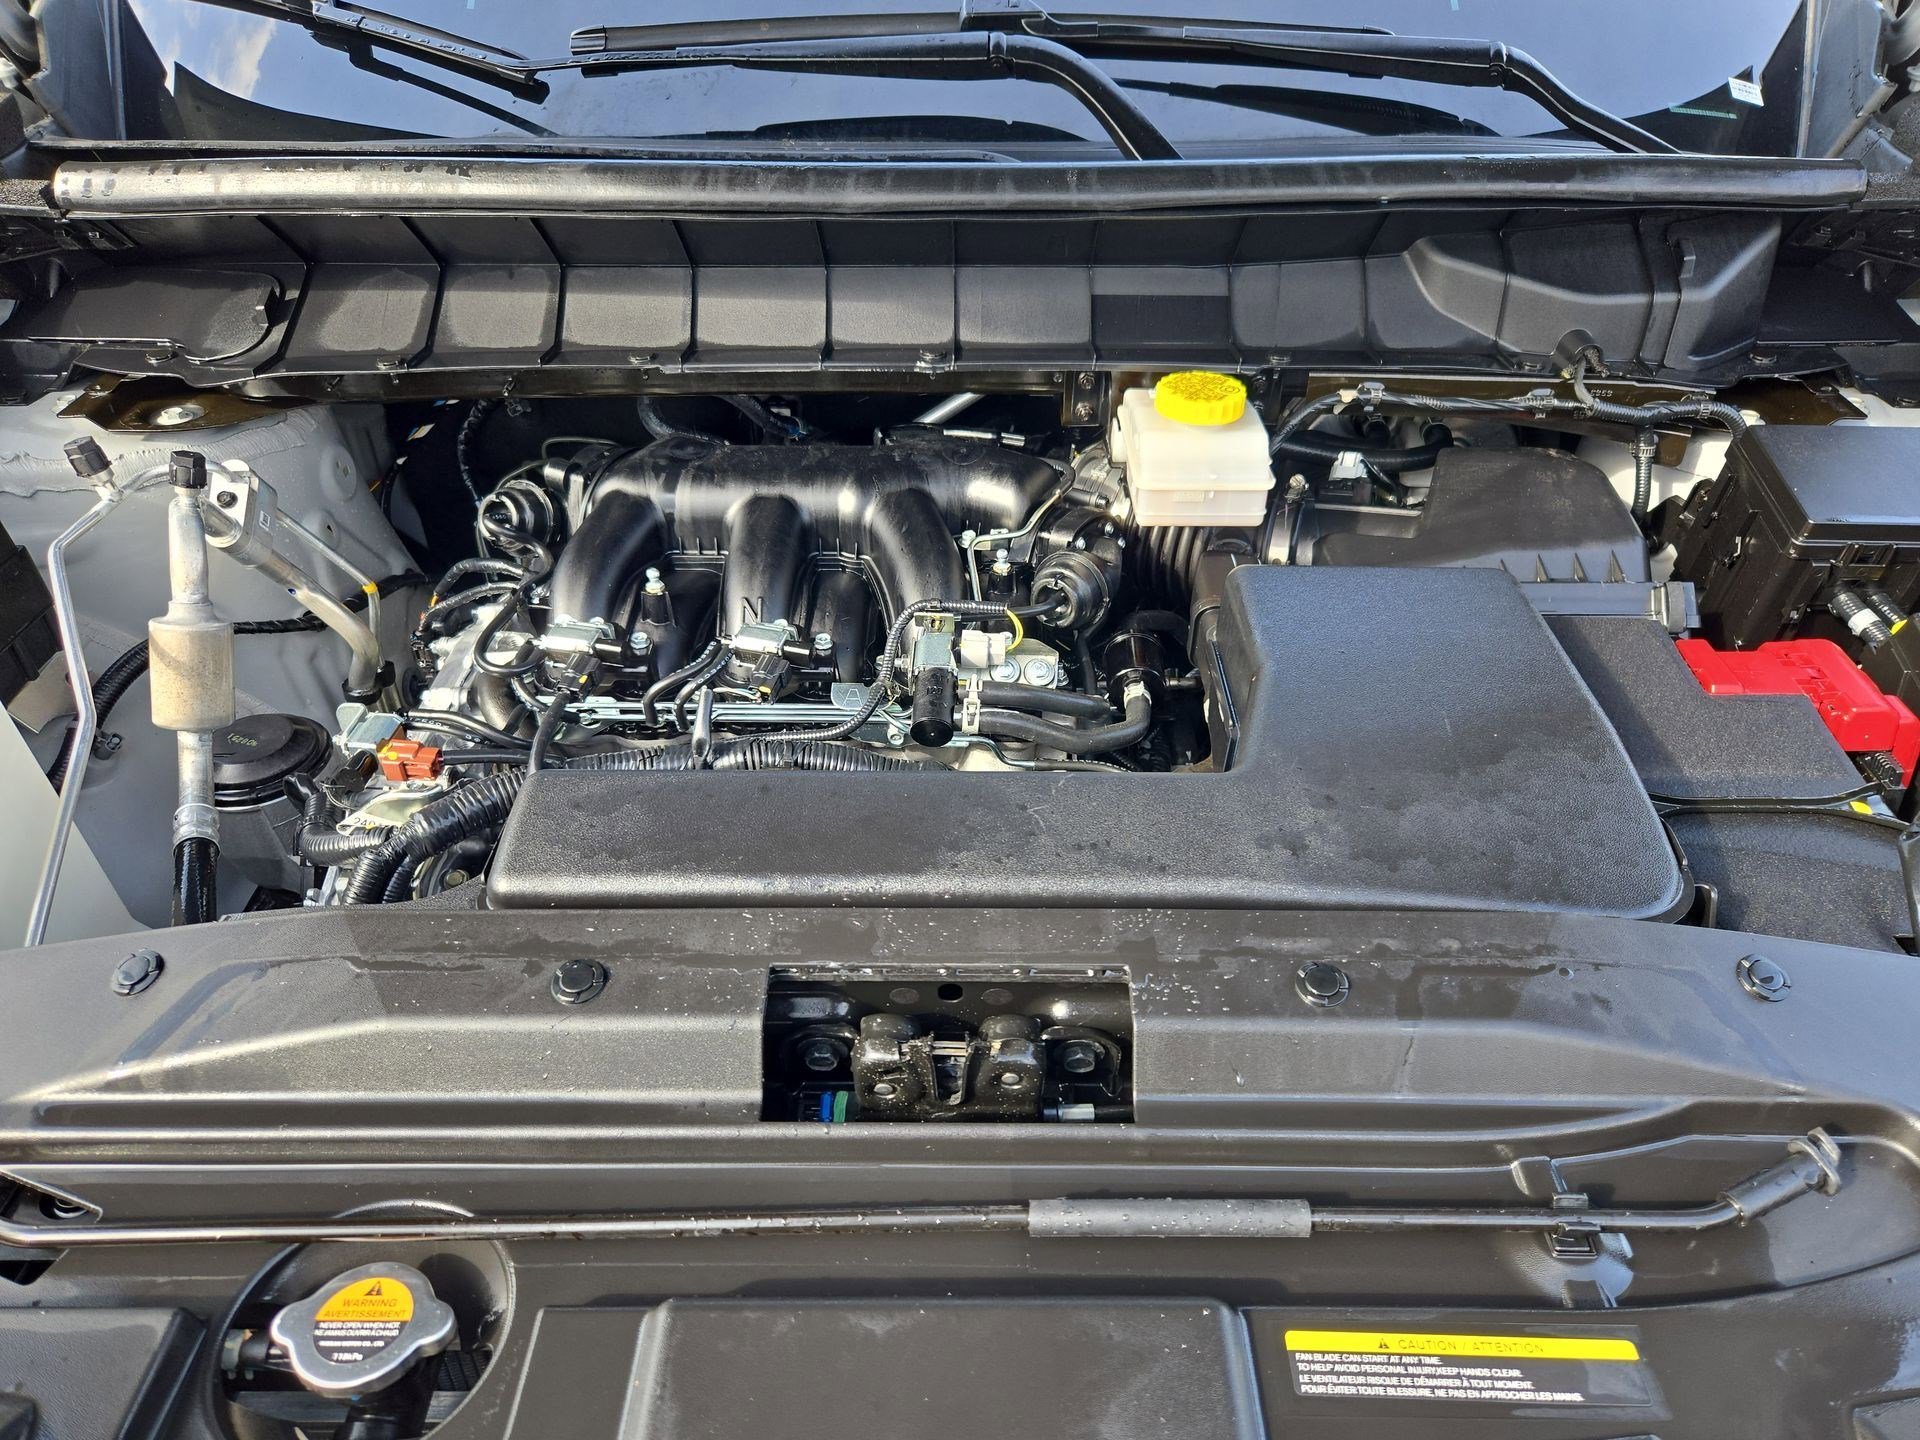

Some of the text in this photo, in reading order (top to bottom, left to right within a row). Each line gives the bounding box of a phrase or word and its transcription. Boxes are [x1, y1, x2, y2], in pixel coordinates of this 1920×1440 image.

[343, 1298, 397, 1307] WARNING
[324, 1310, 407, 1318] AVERTISSEMENT
[1398, 1339, 1456, 1350] CAUTION
[1473, 1342, 1544, 1353] ATTENTION
[1295, 1352, 1443, 1365] FAN BLADE CAN START AT ANY TIME.
[1298, 1363, 1309, 1371] TO
[1310, 1363, 1333, 1371] HELP
[1334, 1364, 1360, 1372] AVOID
[1361, 1364, 1407, 1374] PERSONAL
[1460, 1368, 1490, 1376] HANDS
[1492, 1368, 1523, 1377] CLEAR.
[1300, 1375, 1535, 1389] LE VENTILATEUR RISQUE DE DÉMARRER À TOUT MOMENT.
[1301, 1384, 1328, 1393] POUR
[1328, 1383, 1358, 1394] ÉVITER
[1358, 1386, 1386, 1395] TOUTE
[1387, 1387, 1434, 1397] BLESSURE,
[1435, 1389, 1448, 1397] NE
[1448, 1389, 1467, 1398] PAS
[1467, 1390, 1480, 1398] EN
[1481, 1390, 1535, 1400] APPROCHER
[1535, 1392, 1553, 1401] LES
